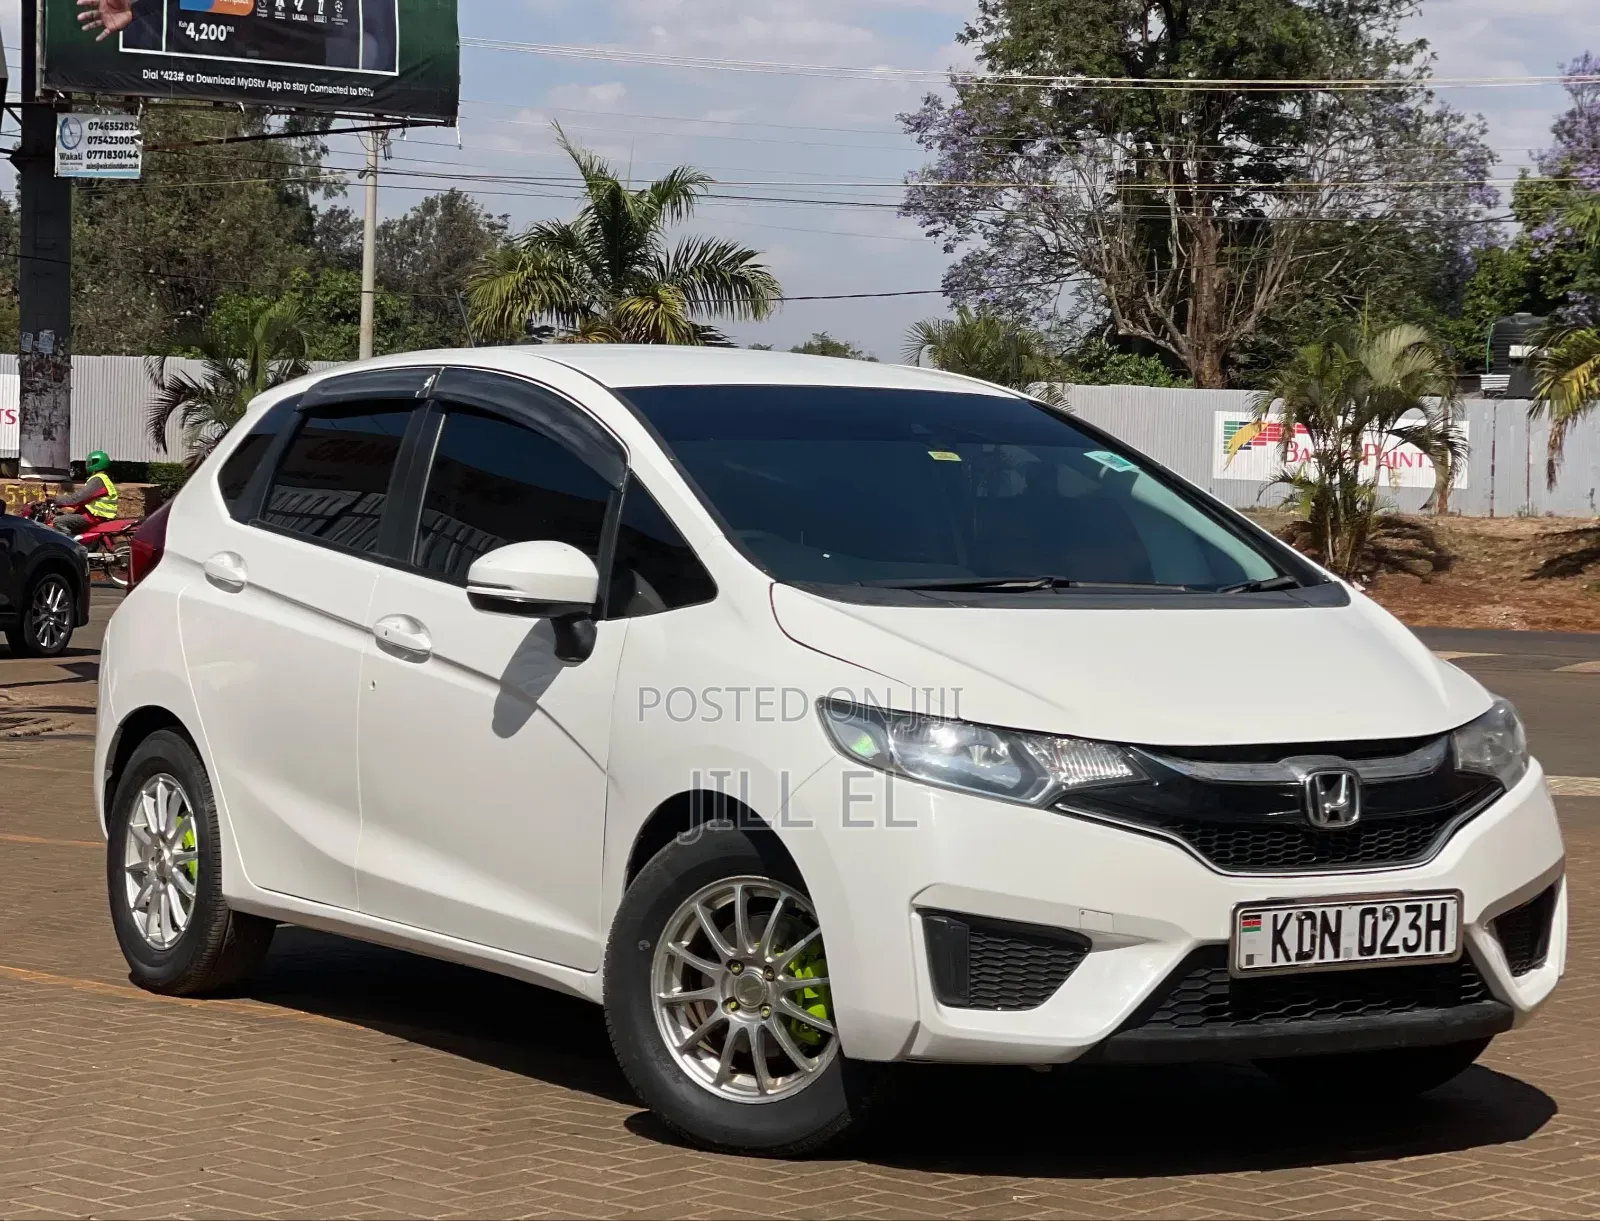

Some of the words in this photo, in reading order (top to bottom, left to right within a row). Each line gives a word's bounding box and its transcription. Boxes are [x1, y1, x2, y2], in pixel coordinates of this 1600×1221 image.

[186, 22, 227, 41] 4,200
[142, 69, 159, 80] Dial
[186, 74, 195, 82] or
[196, 73, 236, 86] Download
[237, 76, 266, 90] MyDStv
[266, 79, 282, 92] App
[283, 80, 291, 90] to
[292, 82, 308, 94] stay
[309, 83, 349, 95] Connected
[349, 86, 357, 96] to
[358, 87, 375, 97] DStv
[59, 152, 83, 161] Wakati
[86, 150, 139, 160] 0771830144
[1363, 443, 1436, 471] PAINT
[1271, 908, 1343, 963] KDN
[1358, 902, 1448, 957] 023H
